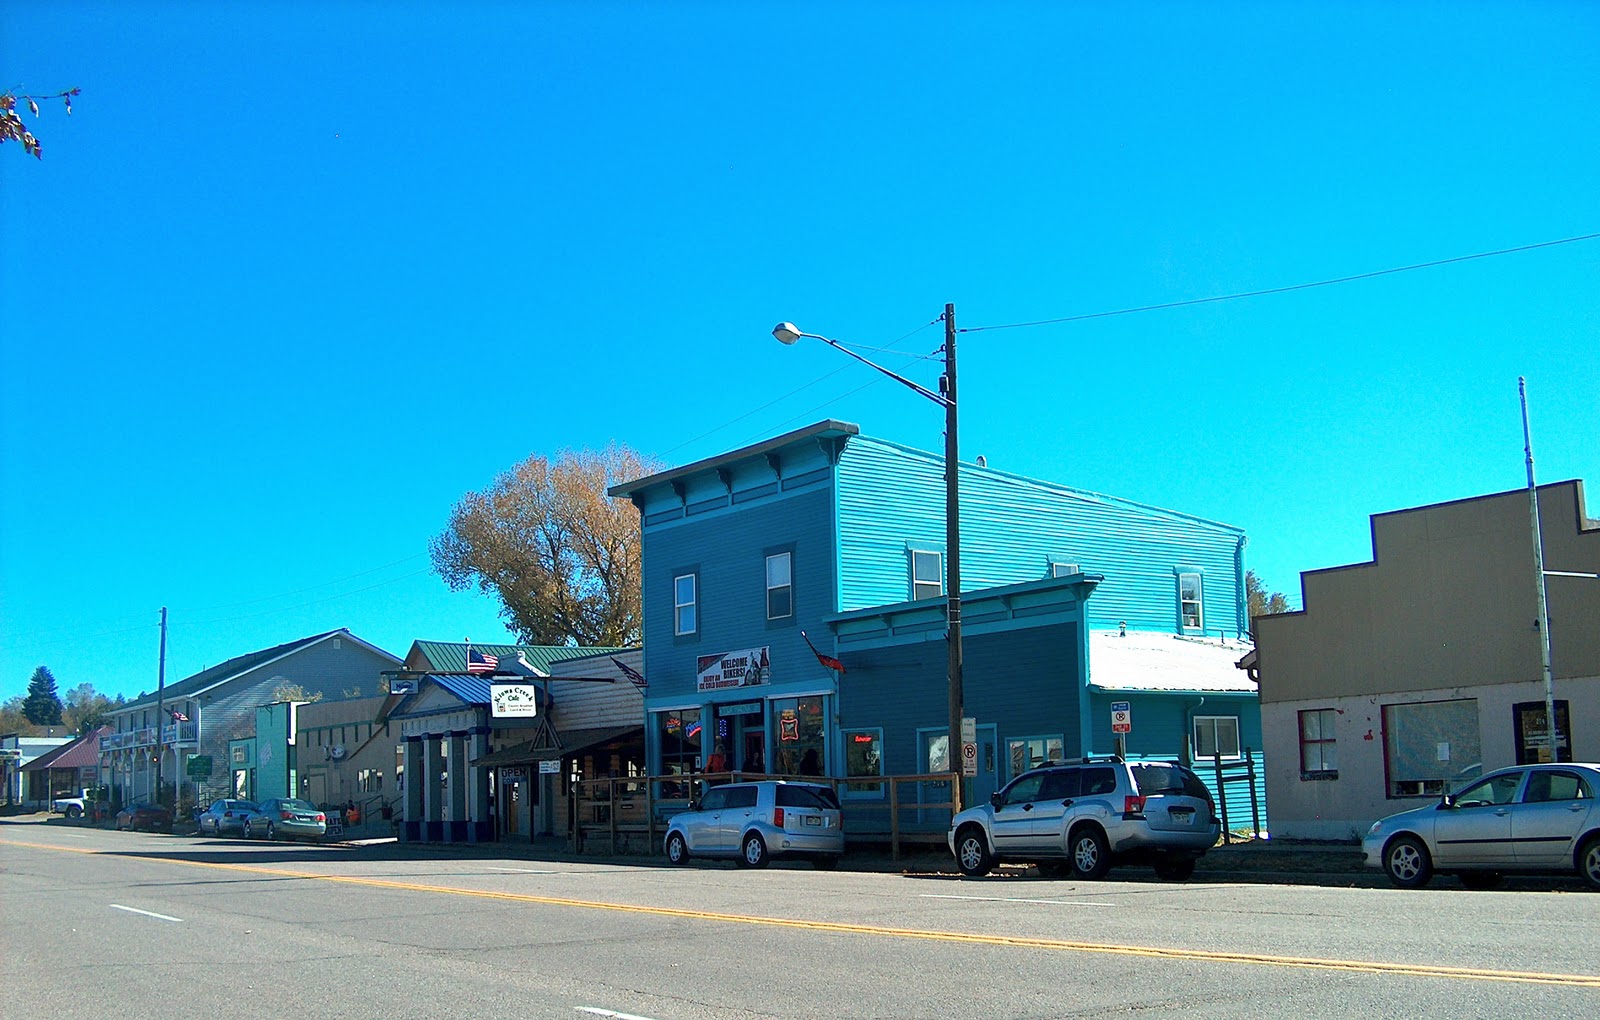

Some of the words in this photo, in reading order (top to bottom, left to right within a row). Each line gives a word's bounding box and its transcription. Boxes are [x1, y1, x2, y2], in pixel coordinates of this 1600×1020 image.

[721, 657, 748, 669] WELCOME
[724, 668, 746, 679] BIKERS!
[501, 768, 526, 777] OPEN
